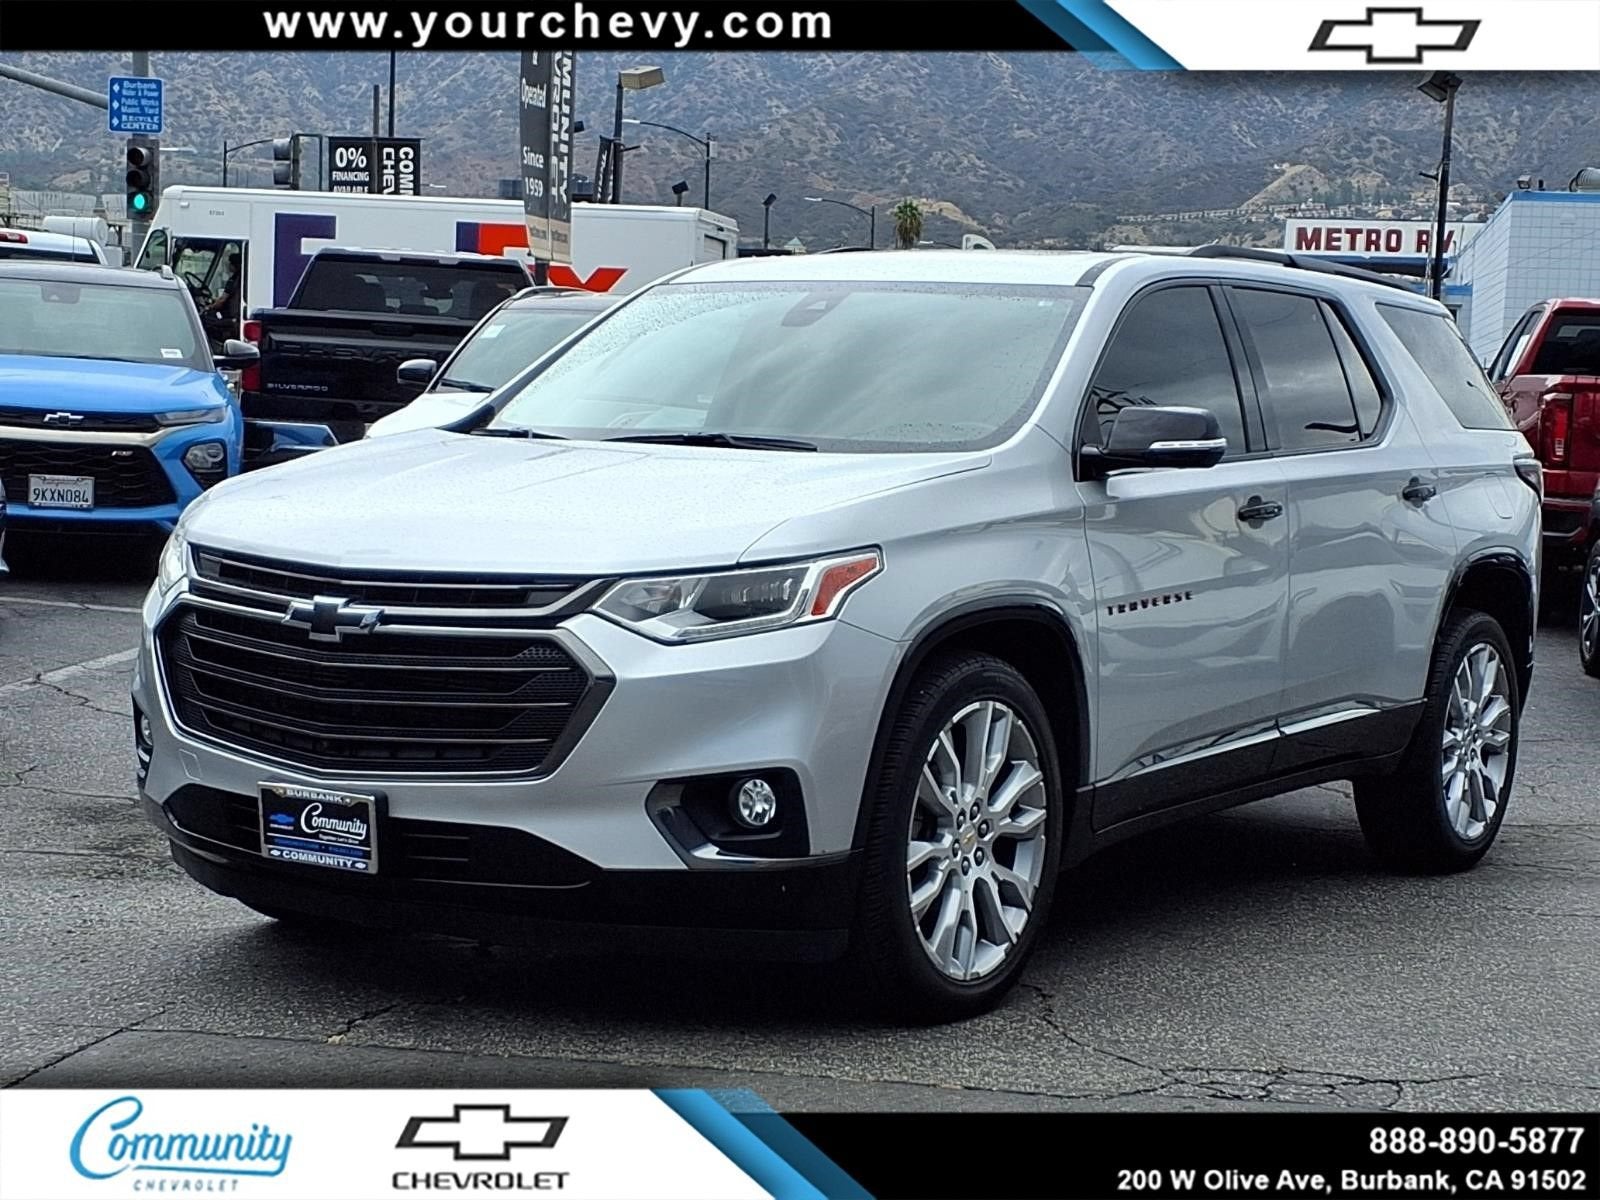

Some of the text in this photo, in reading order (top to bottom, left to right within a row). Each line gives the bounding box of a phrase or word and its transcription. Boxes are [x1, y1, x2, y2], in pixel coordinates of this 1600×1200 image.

[521, 77, 547, 109] Operated
[335, 147, 367, 168] 0%
[523, 145, 545, 168] Since
[332, 171, 370, 182] FINANCING
[524, 176, 544, 198] 1959
[1296, 227, 1403, 253] METRO
[33, 487, 89, 503] 9KXN084
[1107, 591, 1192, 616] TRAVERSE
[287, 789, 343, 803] BURBANK
[301, 803, 367, 840] Community
[282, 850, 353, 868] COMMUNITY
